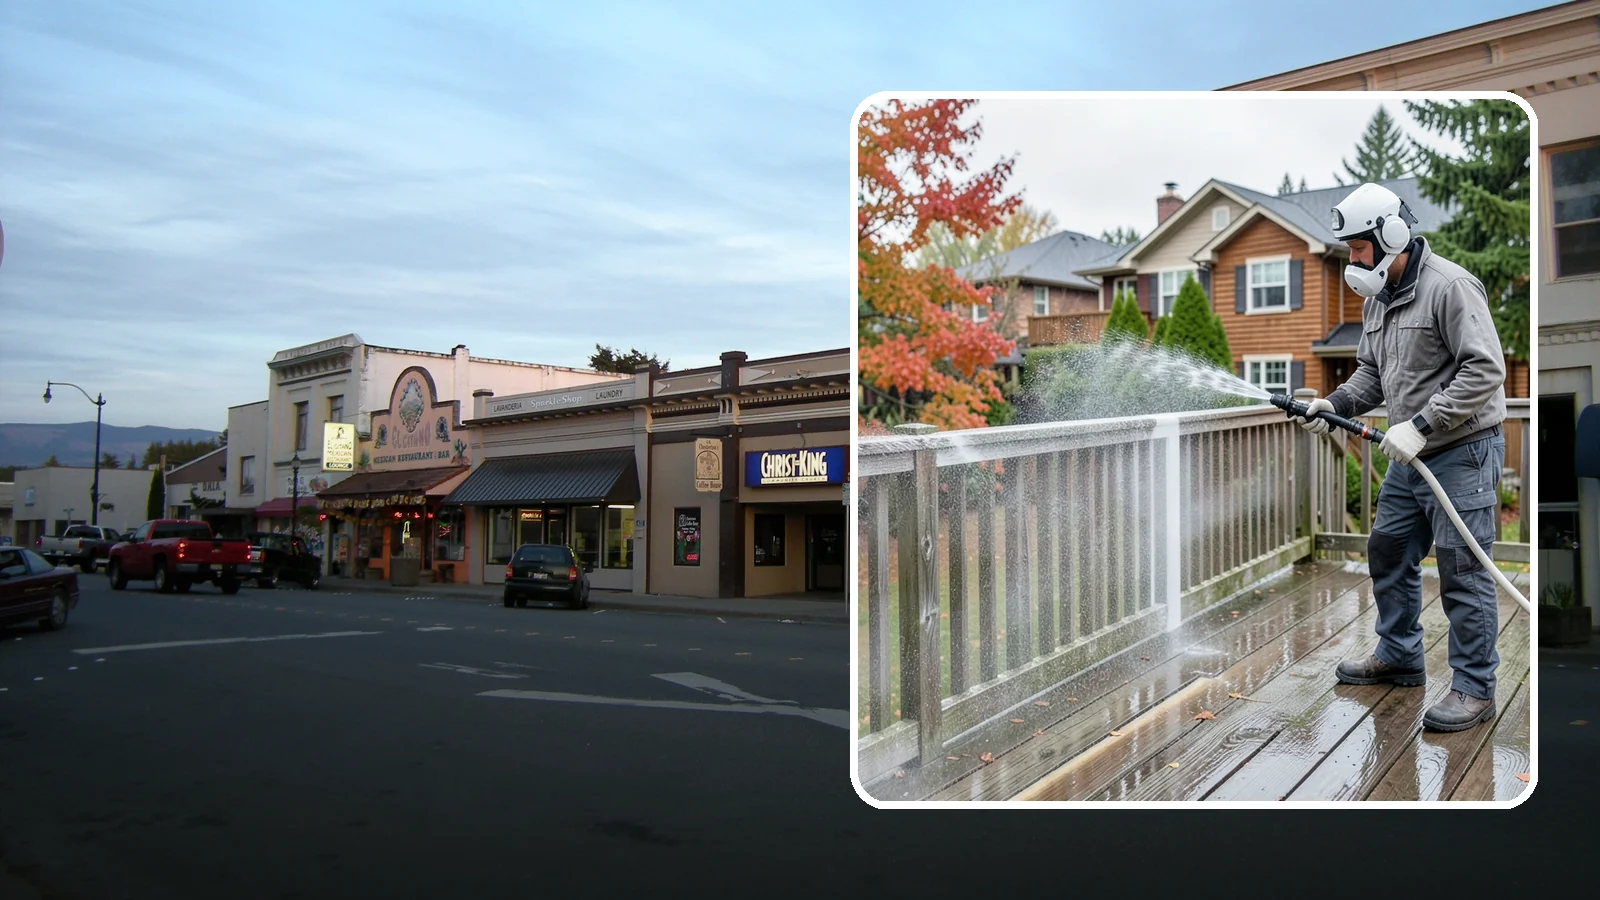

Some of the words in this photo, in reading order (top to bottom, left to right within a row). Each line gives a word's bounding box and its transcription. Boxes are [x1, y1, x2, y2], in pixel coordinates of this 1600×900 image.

[494, 402, 522, 412] LAVANDERIA
[562, 394, 582, 405] Shop
[596, 388, 624, 400] LAUNDRY
[374, 454, 396, 464] MEXICAN
[398, 451, 433, 462] RESTAURANT
[438, 450, 450, 458] BAR
[761, 452, 797, 478] CHRIST
[800, 450, 827, 476] KING
[696, 480, 710, 488] Coffee
